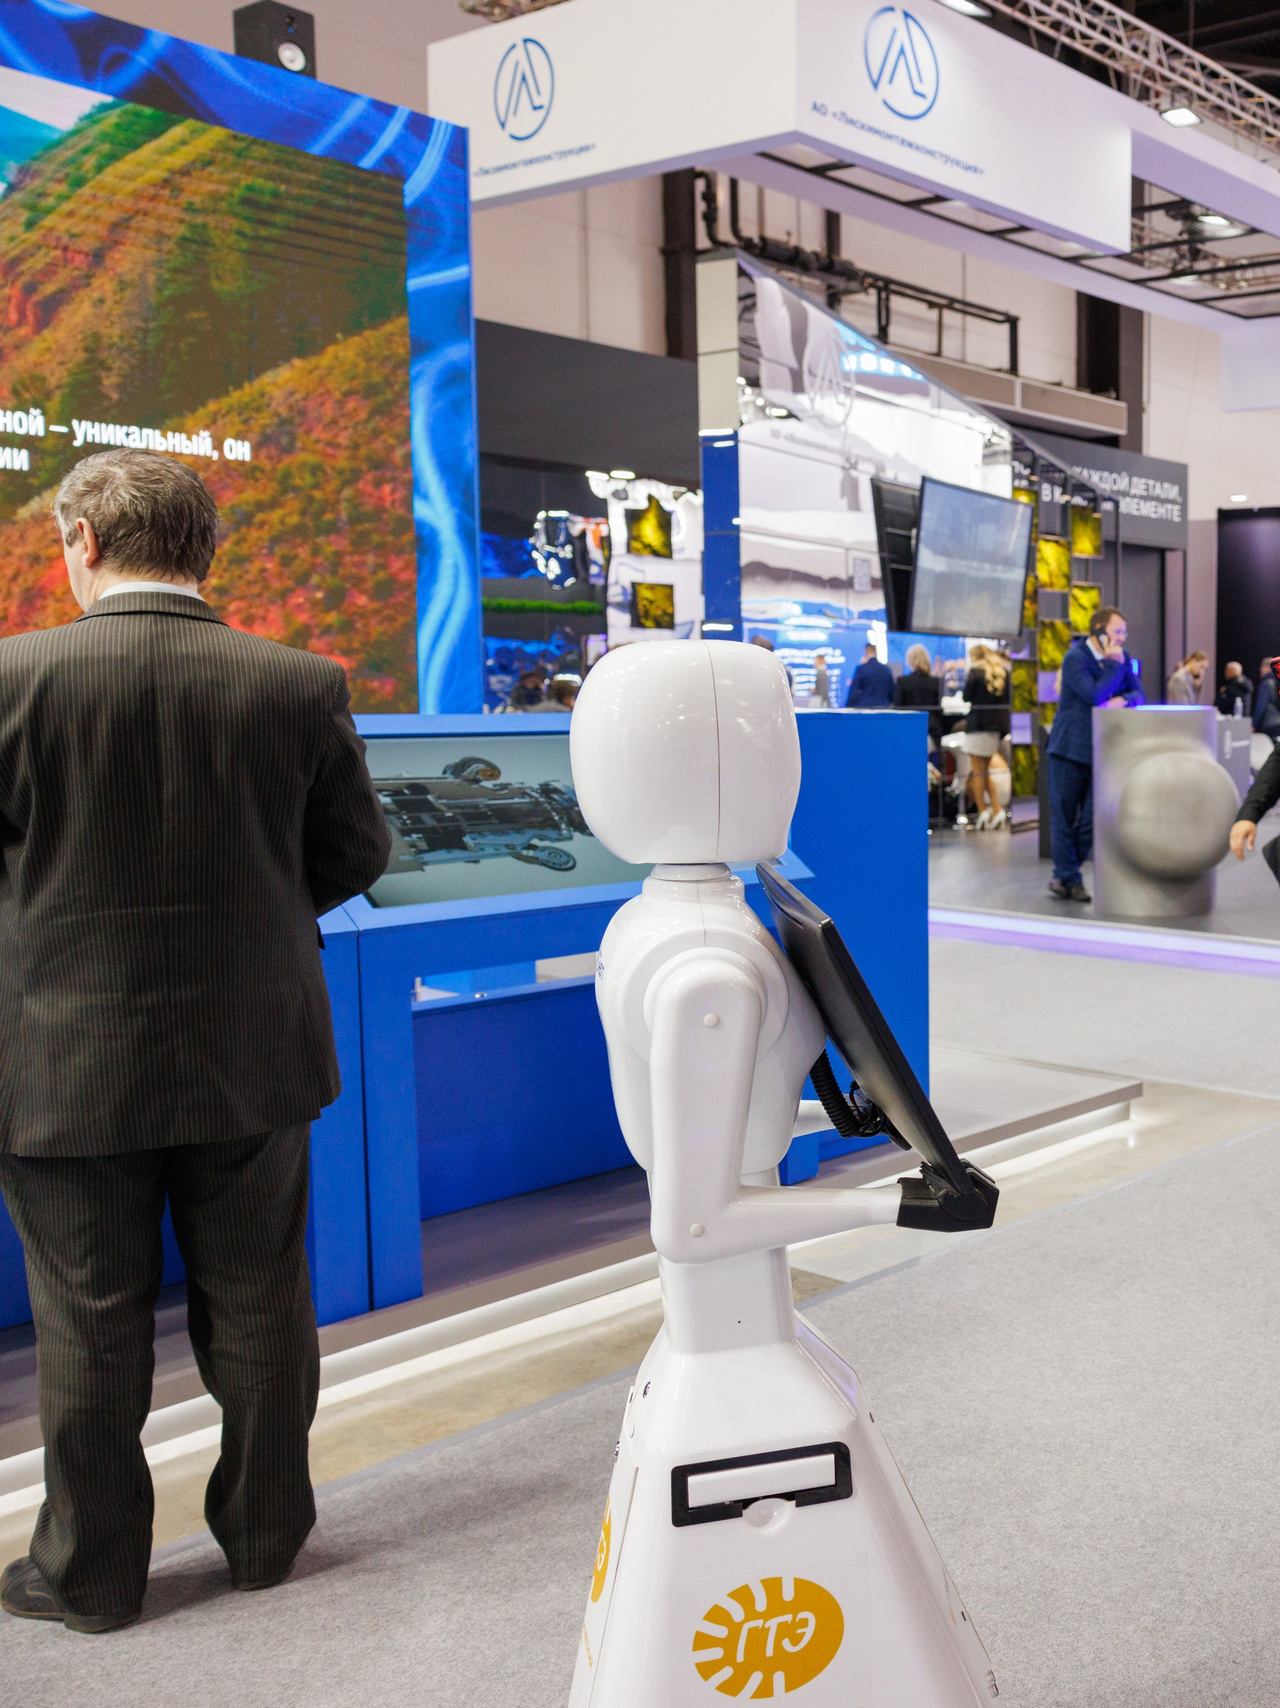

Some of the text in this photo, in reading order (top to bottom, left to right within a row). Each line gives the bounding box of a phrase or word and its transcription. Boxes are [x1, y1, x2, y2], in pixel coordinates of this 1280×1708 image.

[71, 418, 219, 461] уникальный,
[223, 437, 252, 462] он
[1129, 475, 1183, 504] ДЕТАЛИ,
[736, 1611, 816, 1663] ГТЭ
